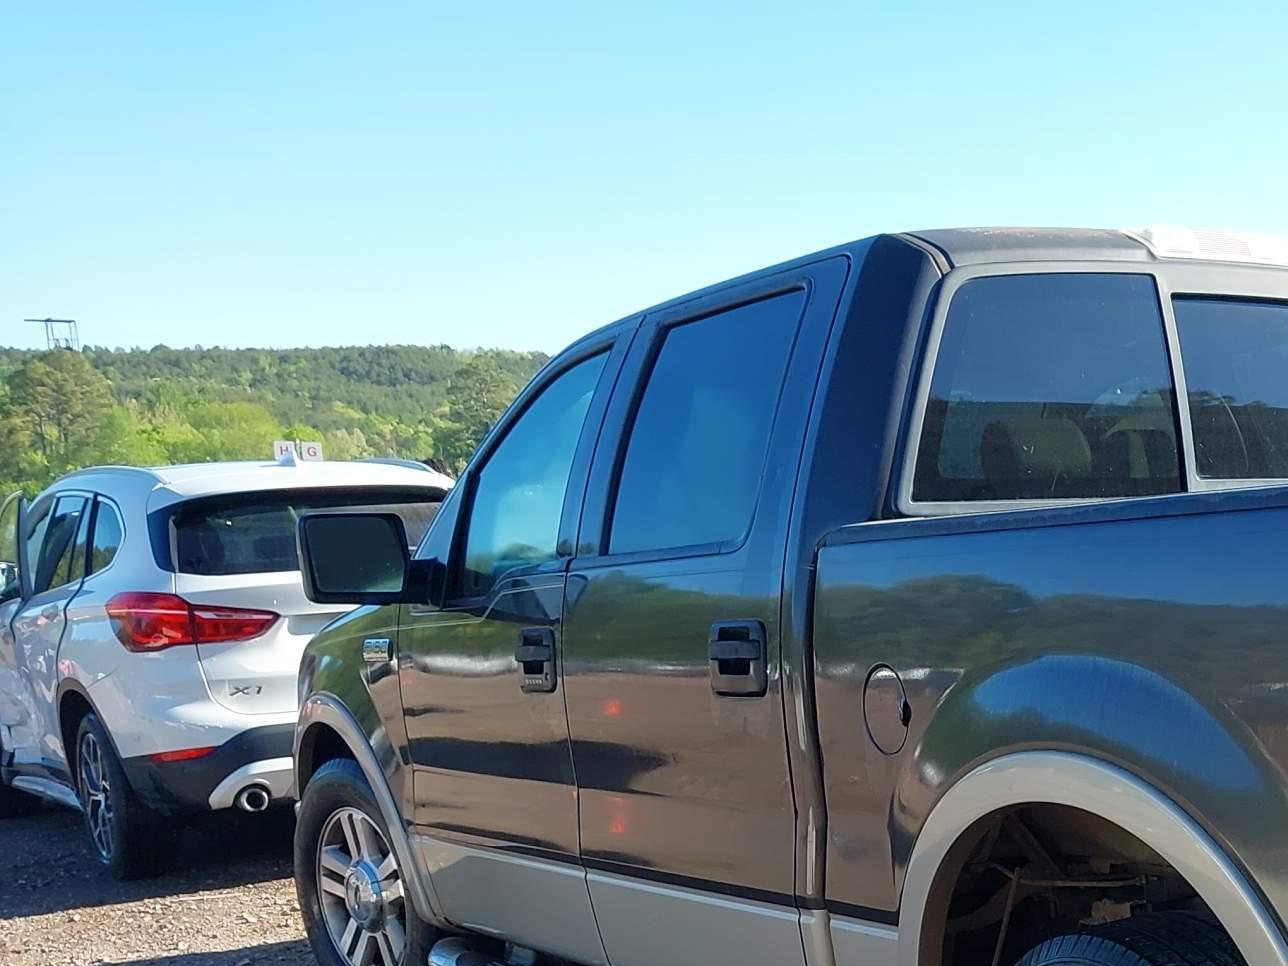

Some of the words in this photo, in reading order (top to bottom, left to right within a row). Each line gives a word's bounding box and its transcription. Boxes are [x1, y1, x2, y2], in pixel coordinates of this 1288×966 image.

[279, 445, 289, 456] H
[307, 446, 317, 457] G
[229, 685, 263, 697] X1
